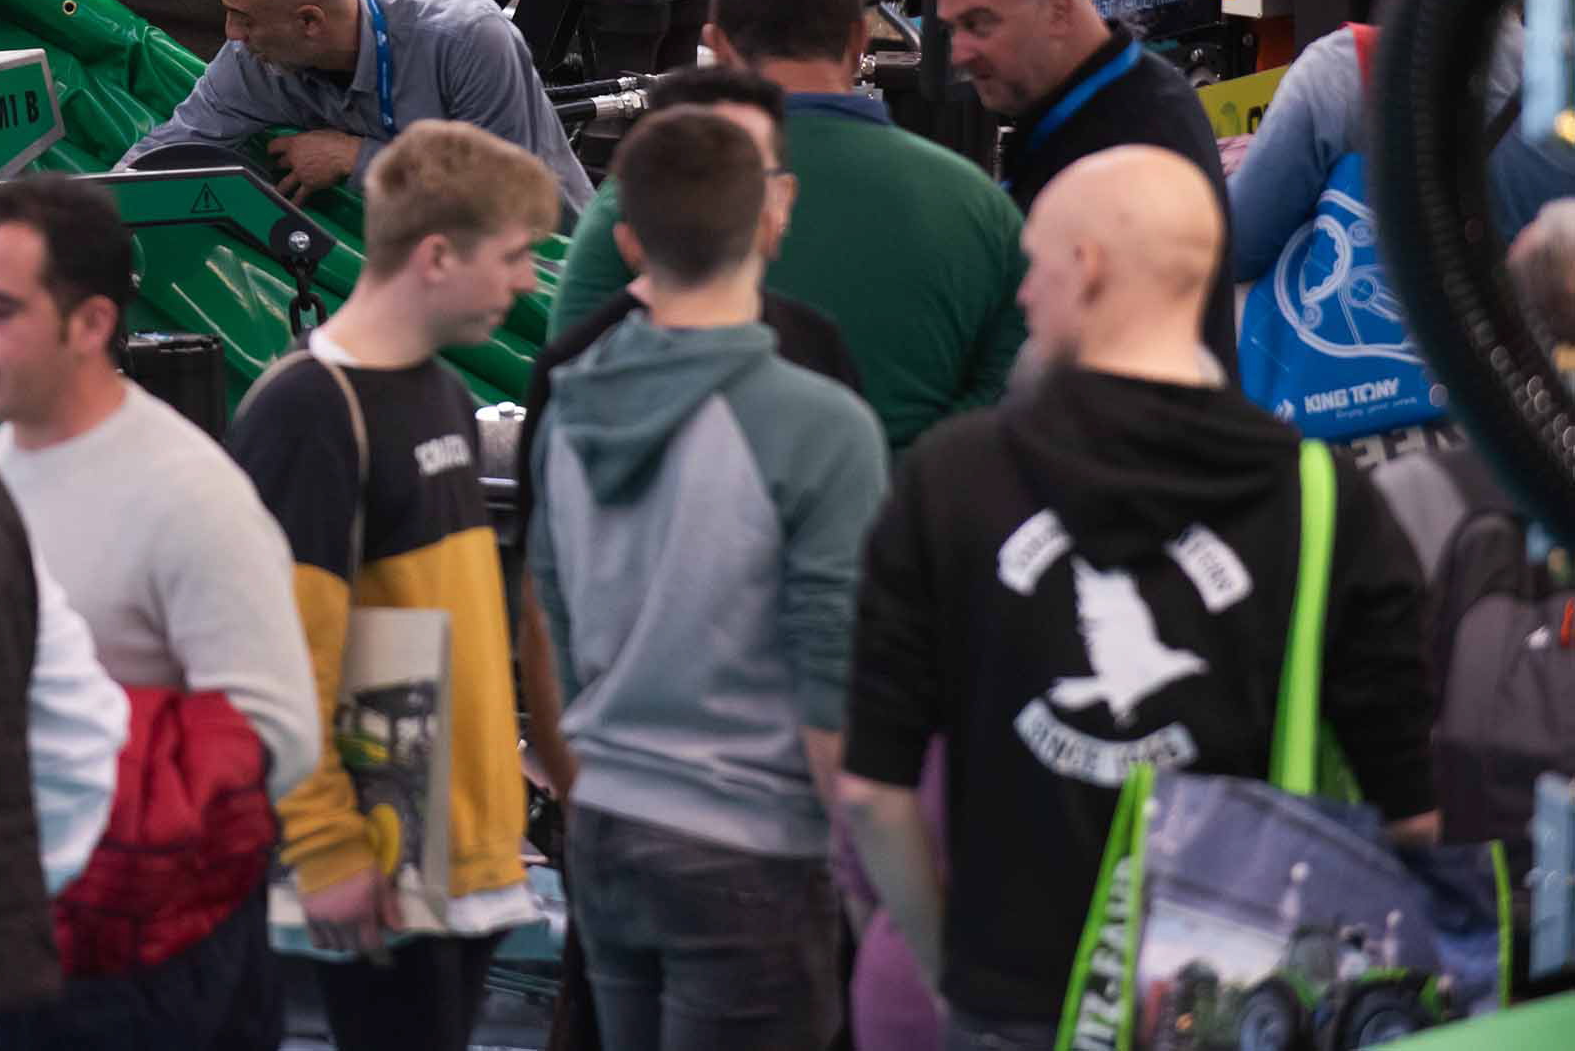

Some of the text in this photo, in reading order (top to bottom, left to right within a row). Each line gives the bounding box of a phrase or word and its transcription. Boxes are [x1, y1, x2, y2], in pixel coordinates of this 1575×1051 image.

[25, 90, 40, 124] B
[1304, 387, 1349, 415] KING
[1349, 377, 1401, 407] TONY
